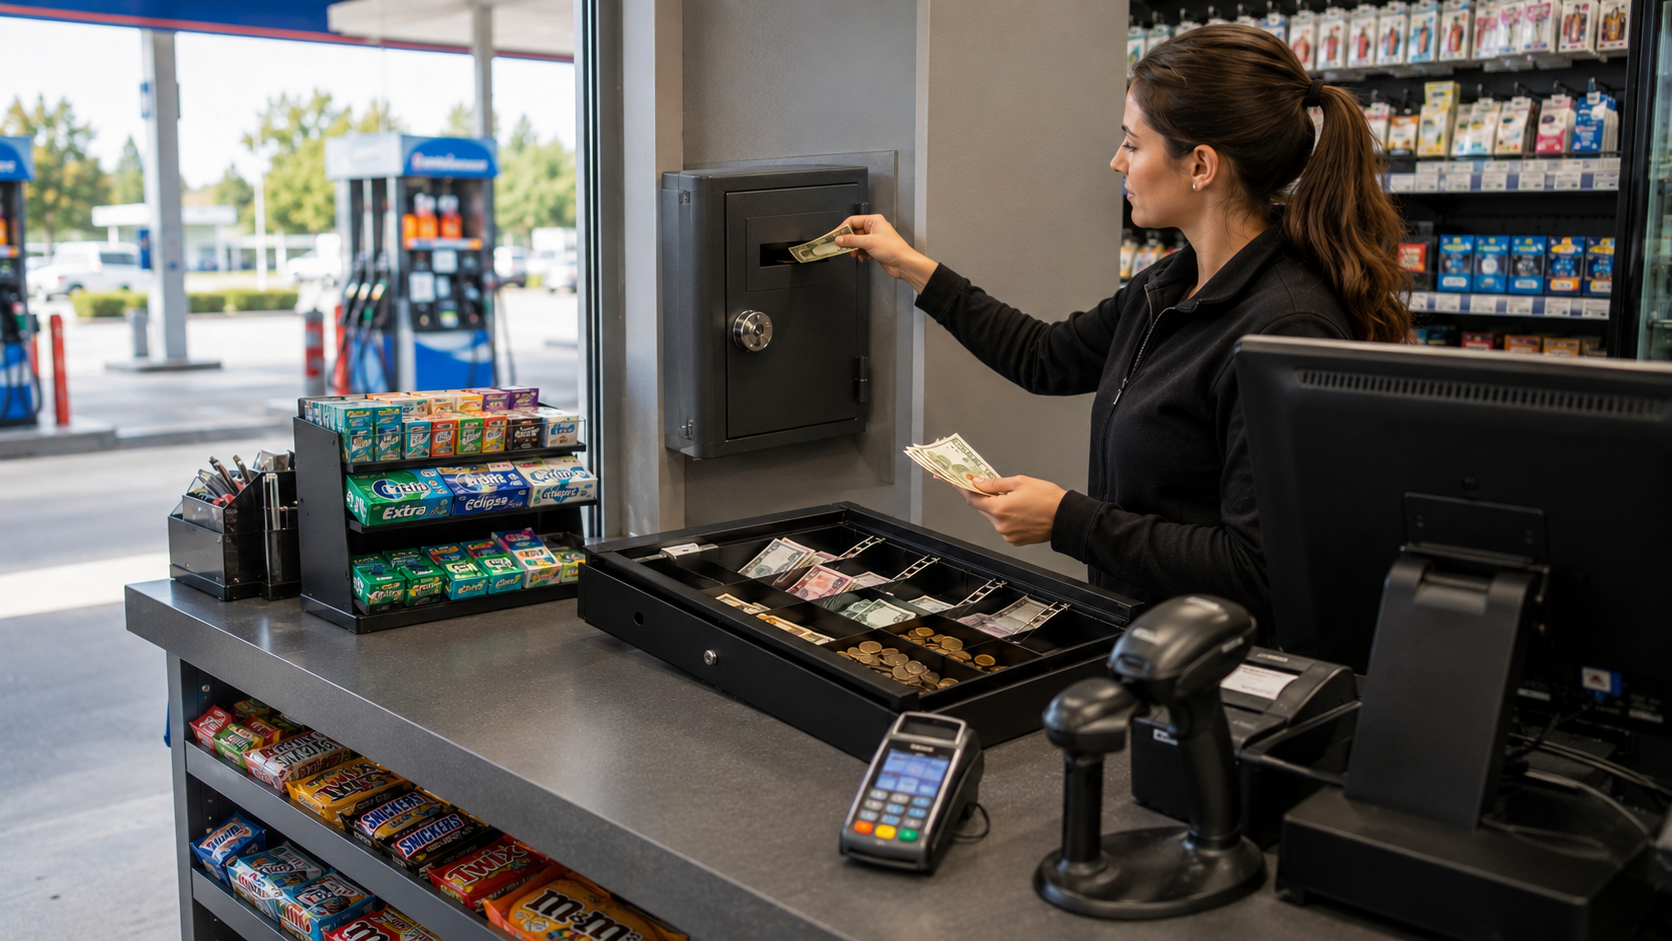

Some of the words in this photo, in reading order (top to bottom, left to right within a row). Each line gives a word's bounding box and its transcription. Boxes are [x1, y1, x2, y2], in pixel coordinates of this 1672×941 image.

[383, 504, 427, 520] Extra
[362, 792, 424, 831] SNICKERS
[398, 814, 464, 857] SNICKERS
